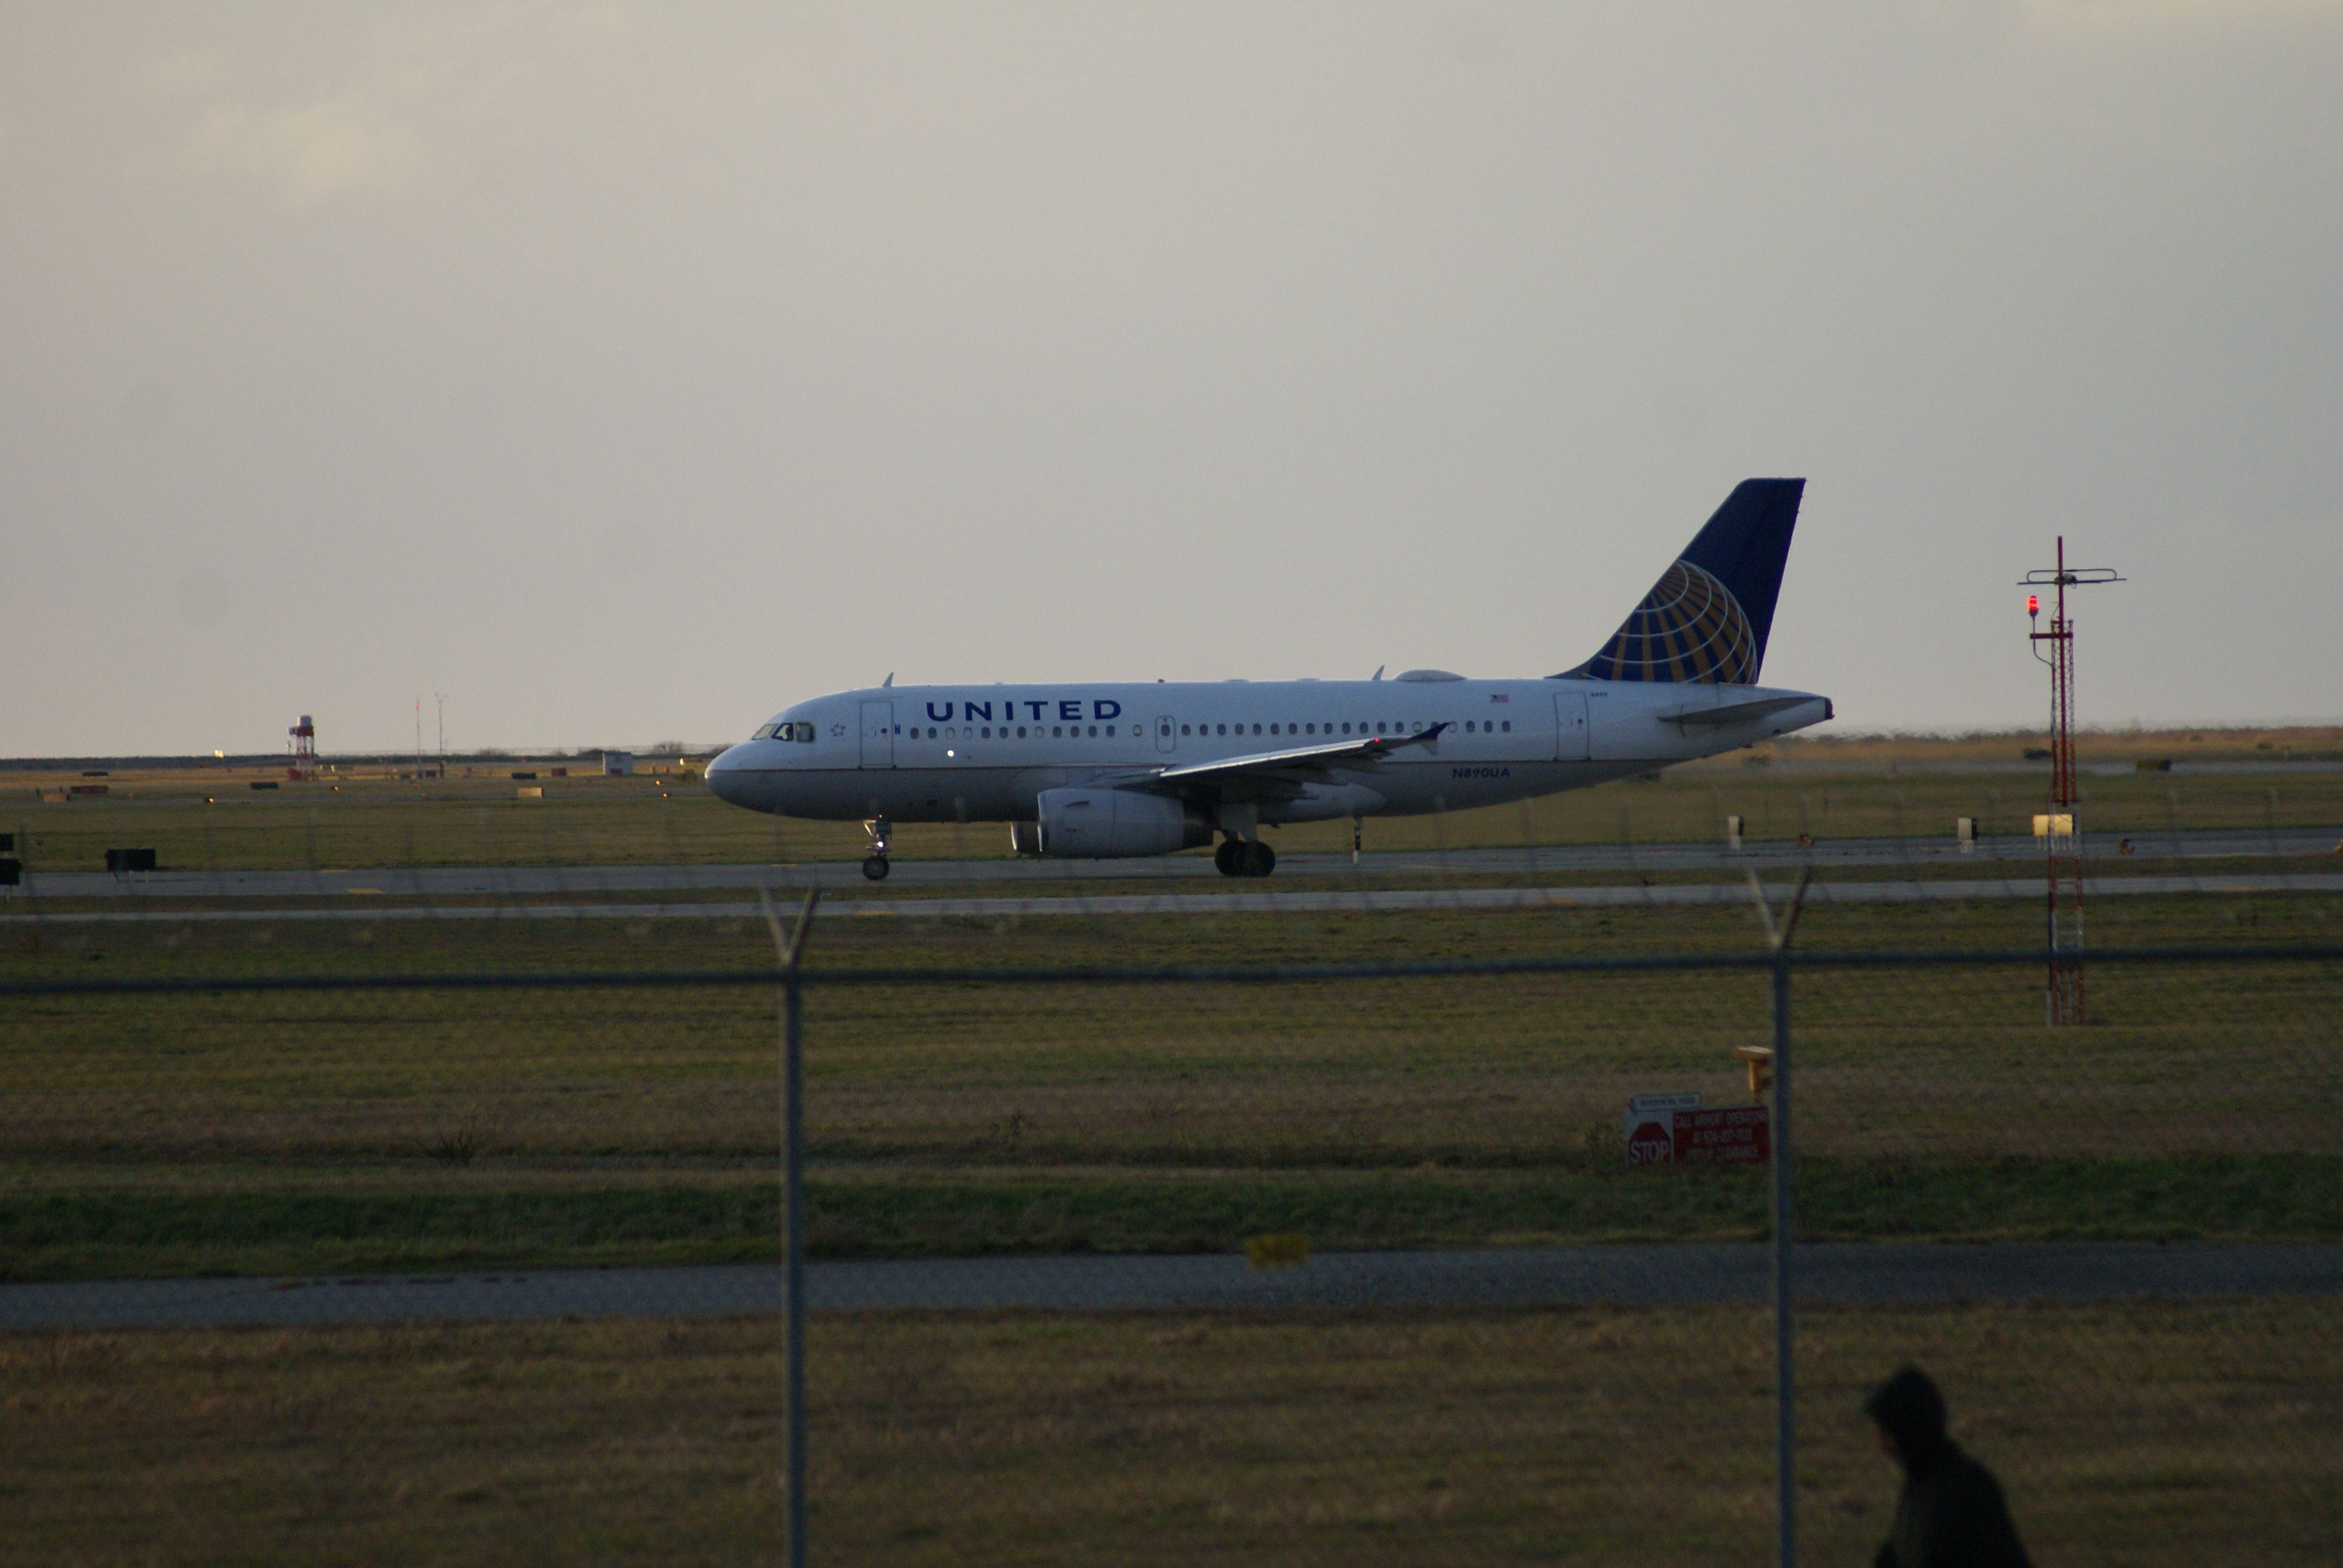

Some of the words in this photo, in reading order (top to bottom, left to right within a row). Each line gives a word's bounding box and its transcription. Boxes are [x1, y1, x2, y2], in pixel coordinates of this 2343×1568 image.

[926, 700, 1121, 722] UNITED
[1453, 767, 1510, 778] N890UA
[1631, 1140, 1670, 1163] STOP
